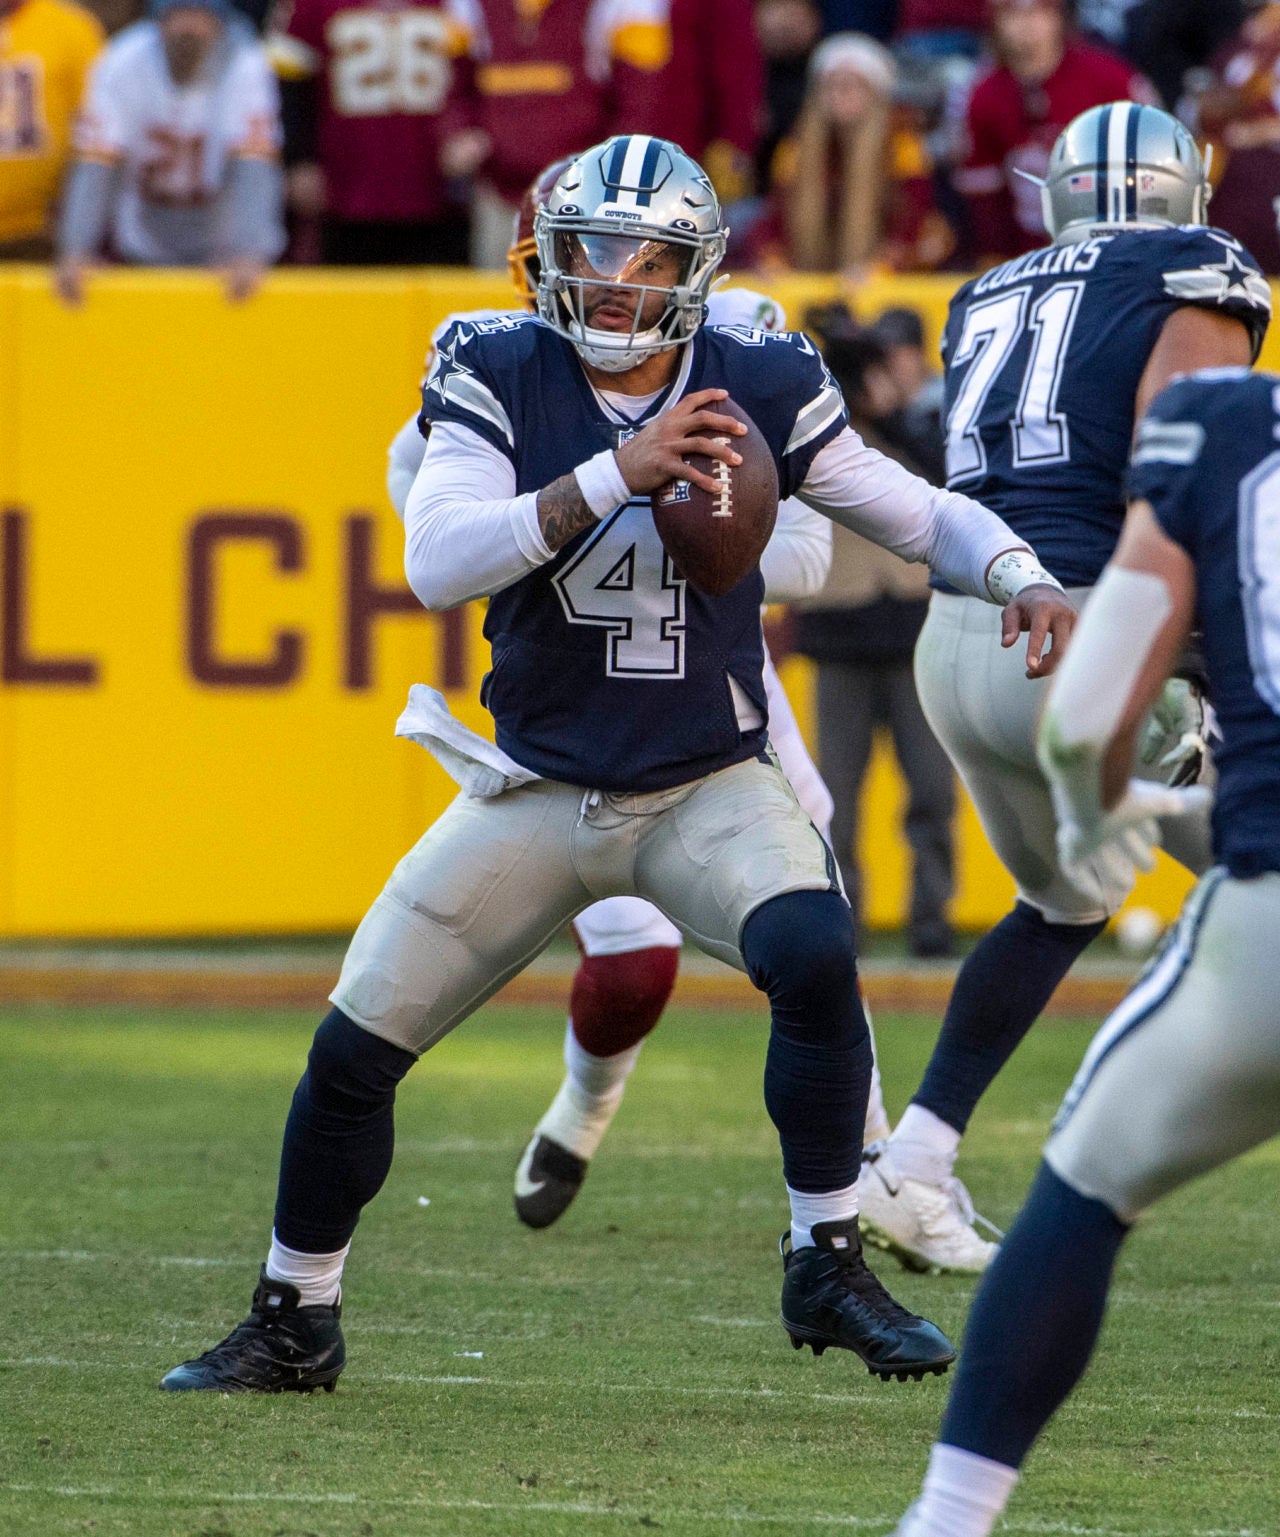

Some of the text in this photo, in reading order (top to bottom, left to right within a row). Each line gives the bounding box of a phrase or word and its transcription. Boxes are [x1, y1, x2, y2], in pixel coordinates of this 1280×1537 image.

[324, 12, 454, 118] 26
[604, 209, 643, 221] COWBOYS
[972, 234, 1116, 296] COLLINS
[945, 279, 1087, 490] 71
[550, 495, 688, 681] 4
